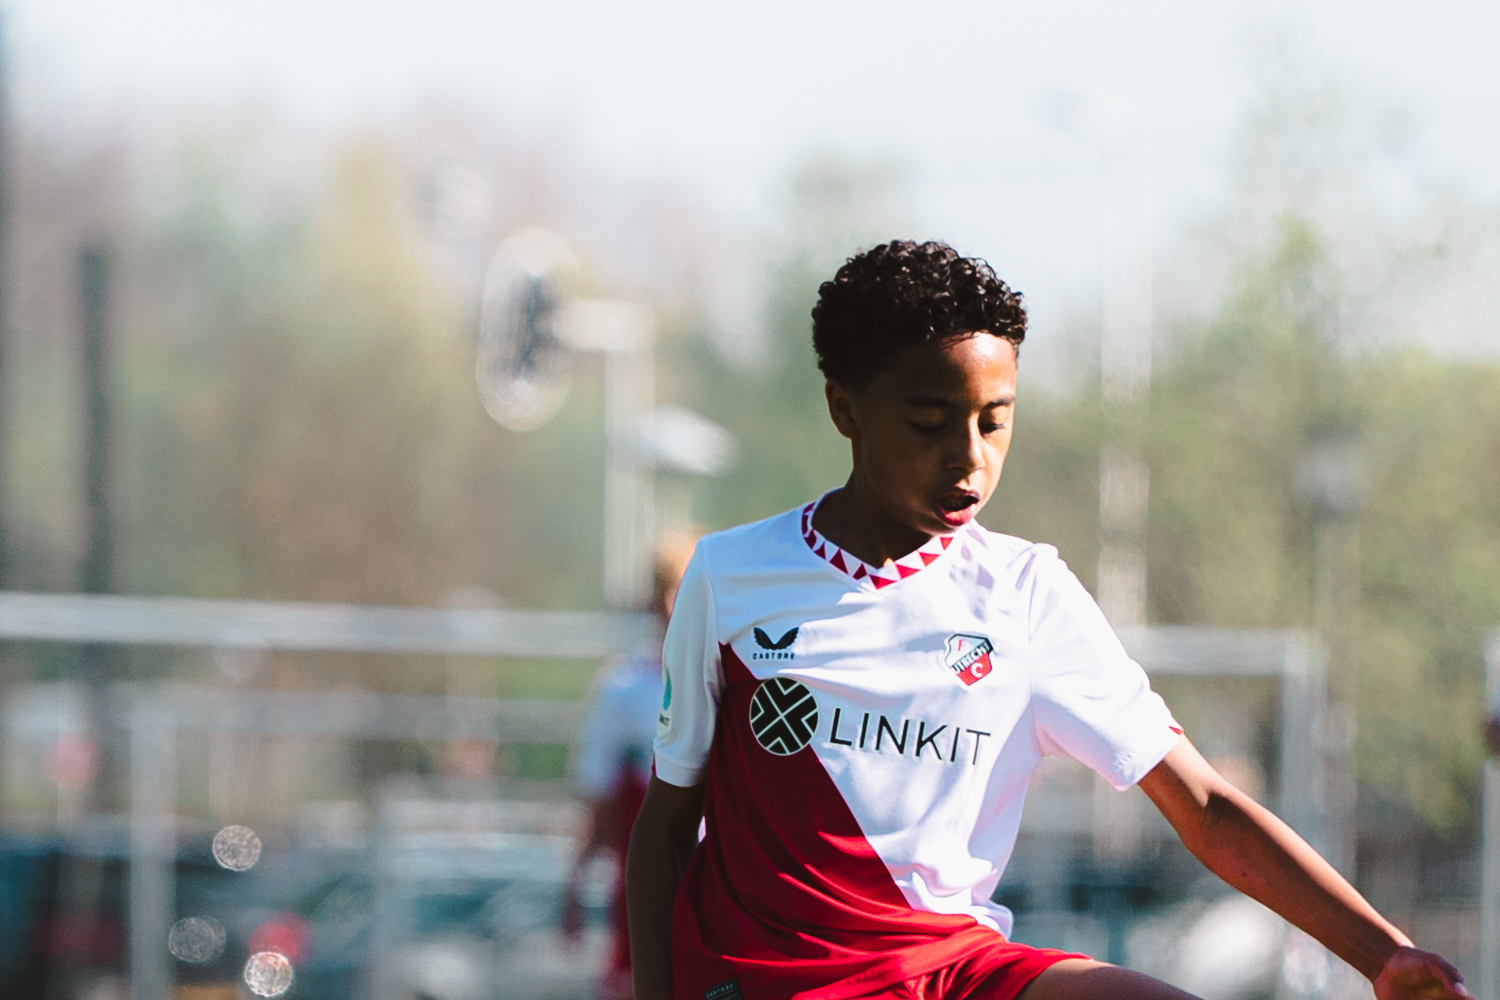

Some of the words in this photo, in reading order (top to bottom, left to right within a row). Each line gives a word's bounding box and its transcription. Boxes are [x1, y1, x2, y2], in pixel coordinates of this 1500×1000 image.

[752, 652, 795, 660] CASTORE
[970, 662, 983, 678] C
[829, 707, 991, 766] LINKIT
